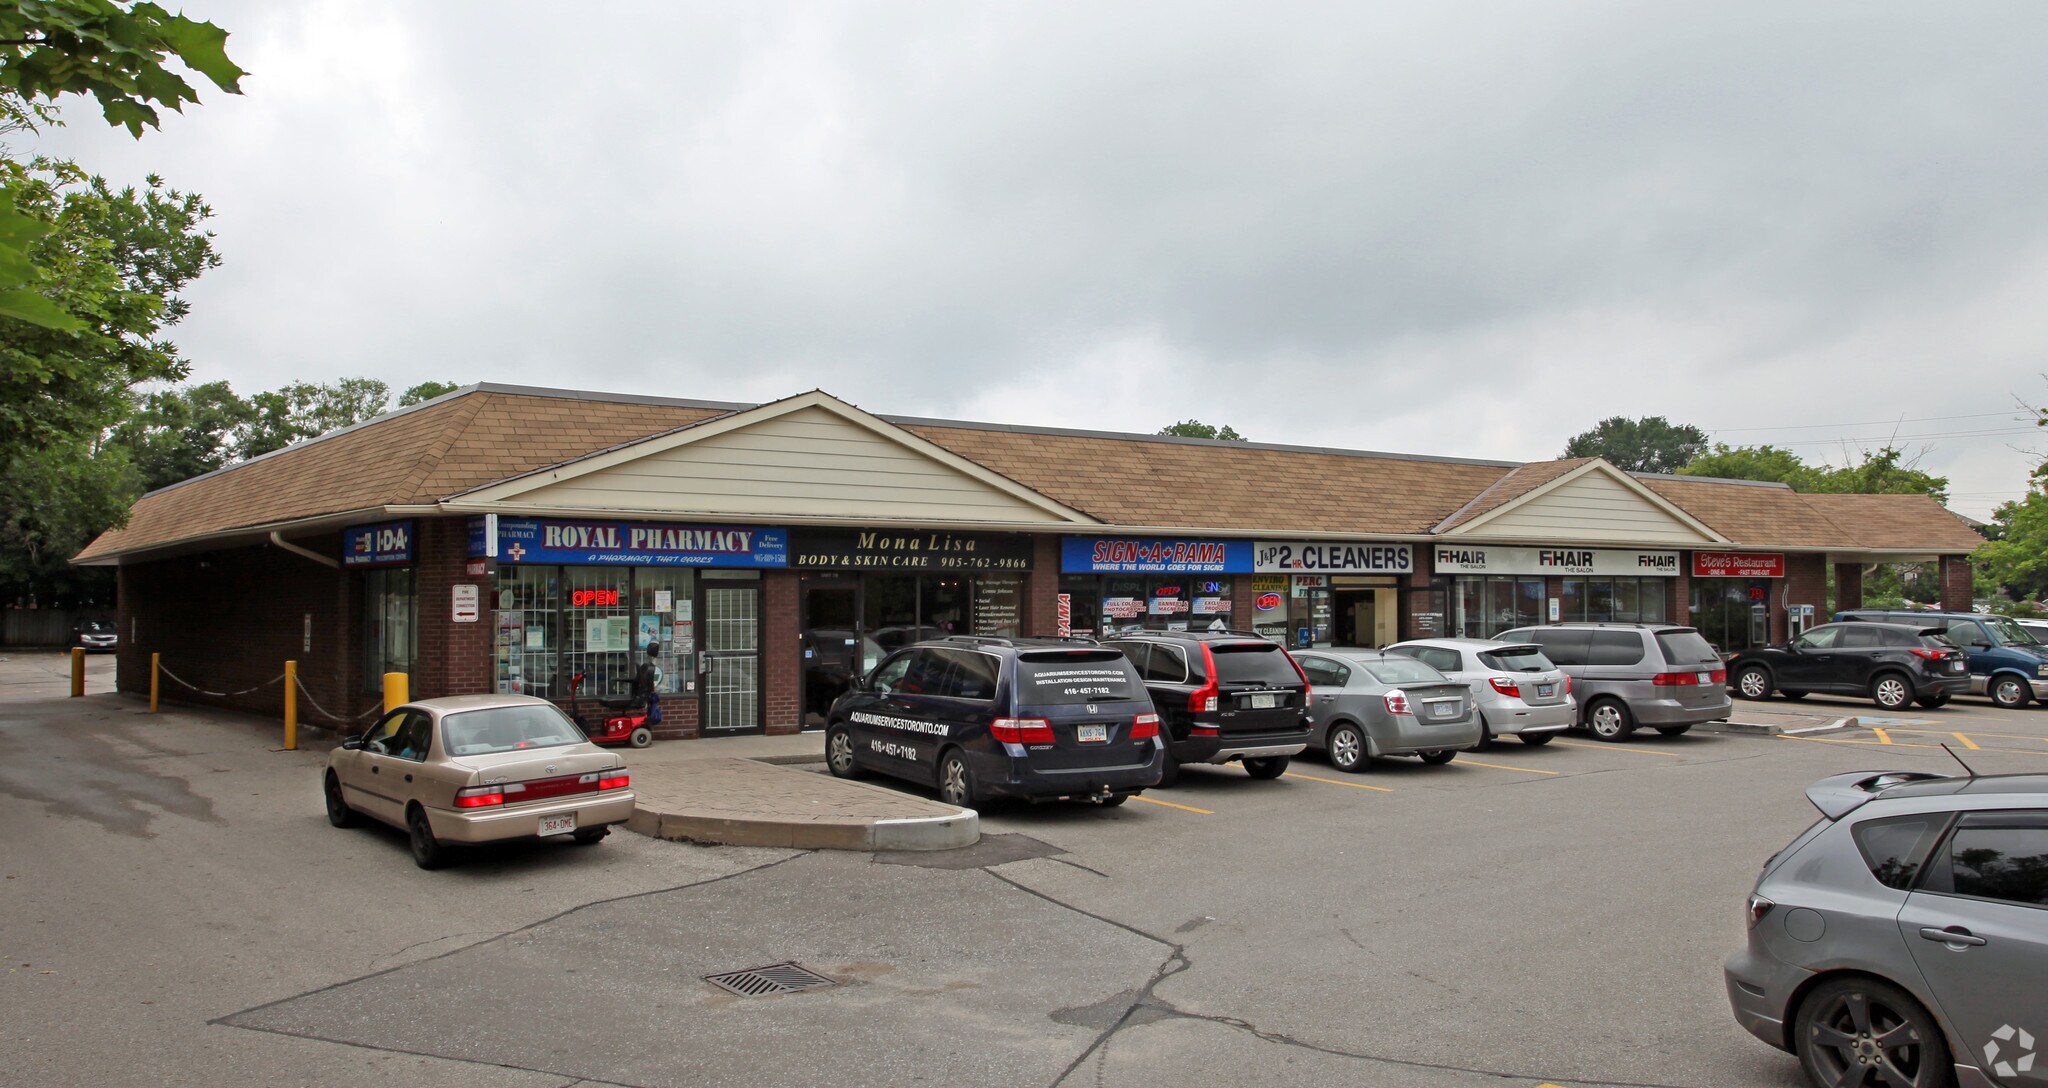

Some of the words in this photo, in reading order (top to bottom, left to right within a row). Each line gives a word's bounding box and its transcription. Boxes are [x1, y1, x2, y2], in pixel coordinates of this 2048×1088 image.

[544, 525, 621, 549] ROYAL
[629, 528, 752, 552] PHARMACY
[857, 532, 920, 550] Mona
[928, 534, 975, 551] Lisa
[759, 541, 783, 550] Delivery
[598, 554, 652, 563] PHARMACY
[656, 555, 679, 563] THAT
[798, 555, 837, 565] BODY
[841, 555, 850, 565] &
[854, 555, 888, 566] SKIN
[892, 556, 928, 566] CARE
[1279, 545, 1292, 569] 2
[1292, 559, 1303, 569] HR
[1303, 546, 1409, 570] CLEANERS
[1701, 554, 1731, 567] Steve's
[1733, 557, 1776, 568] Restaurant
[1253, 575, 1284, 583] ENVIRO
[1296, 576, 1322, 586] PERC
[572, 590, 618, 606] OPEN
[1256, 596, 1281, 607] OPEN
[1034, 670, 1124, 678] AQUARIUMSERVICESTORONTO.COM
[850, 711, 949, 736] AQUARIUMSERVICESTORONTO.COM
[871, 739, 916, 760] 416-457-7182
